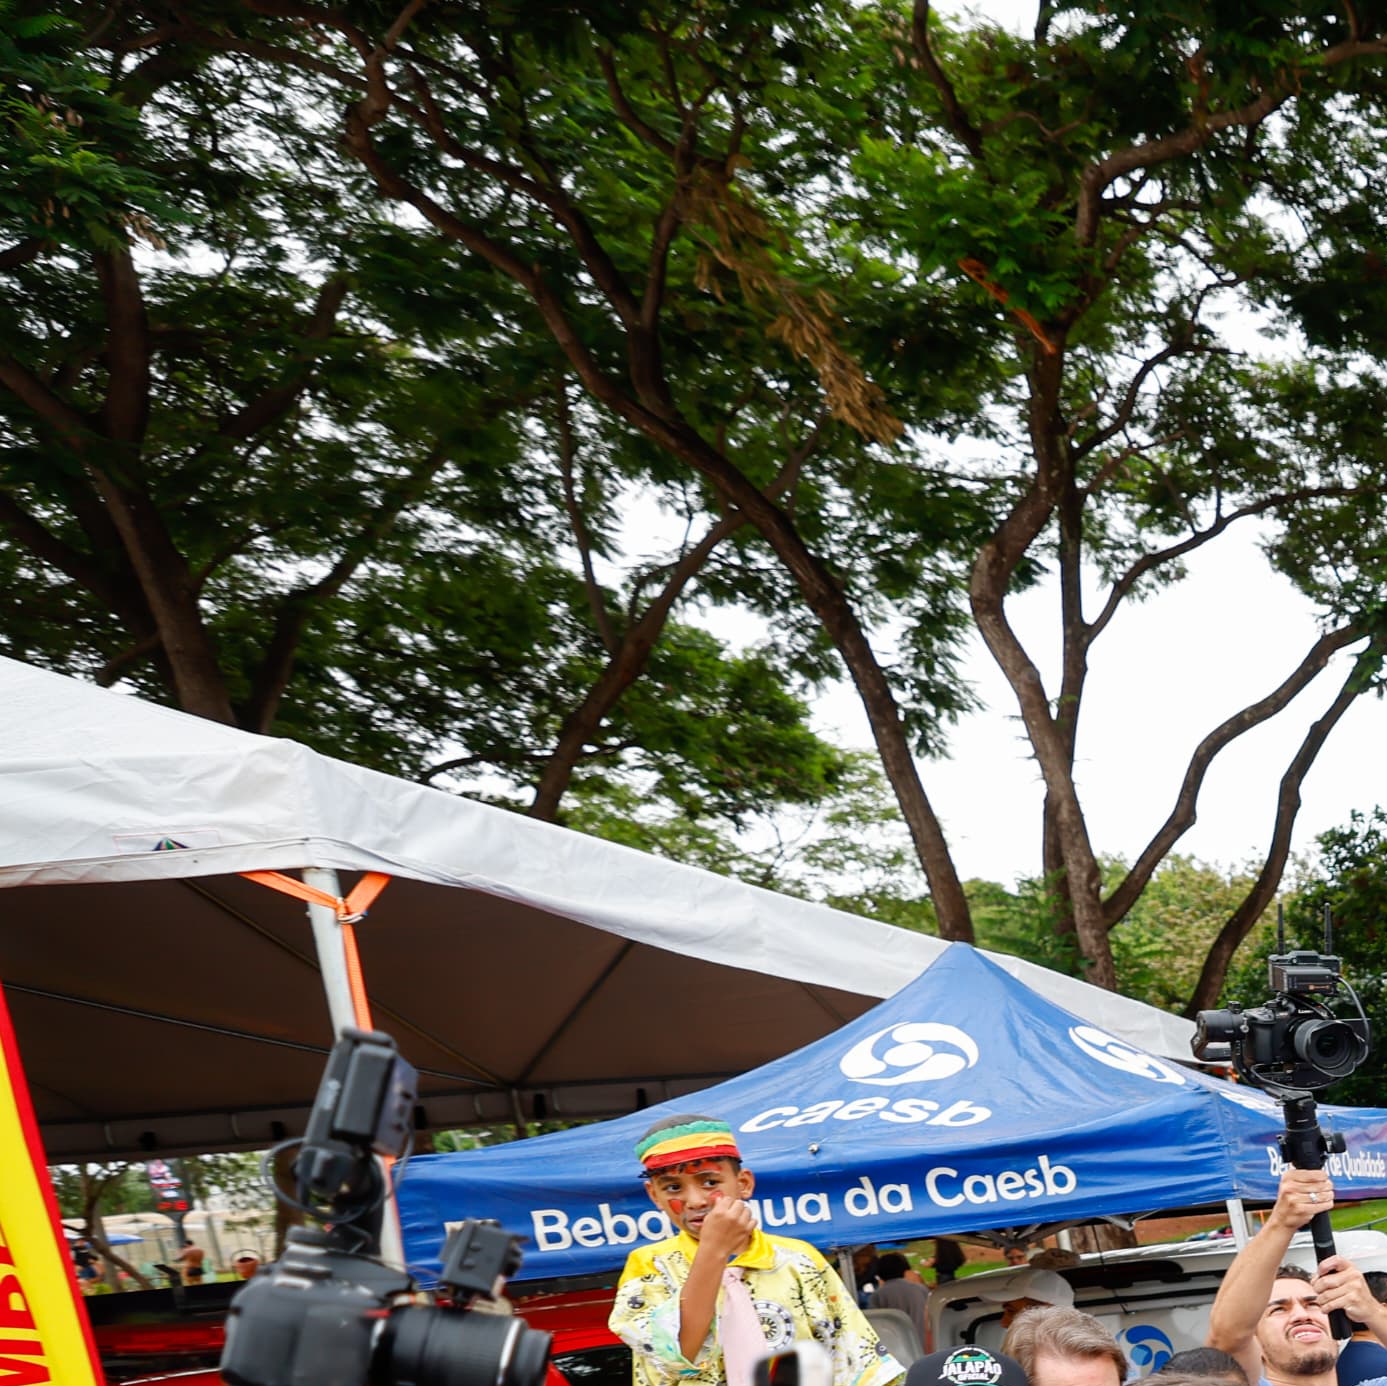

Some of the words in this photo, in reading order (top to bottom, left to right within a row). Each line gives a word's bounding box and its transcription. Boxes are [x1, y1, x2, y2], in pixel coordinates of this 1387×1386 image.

[739, 1097, 992, 1133] caesb
[1342, 1150, 1386, 1181] Qualidade
[530, 1203, 675, 1252] Beba
[844, 1176, 914, 1217] da
[925, 1154, 1077, 1209] Caesb
[938, 1360, 1002, 1379] JALAPÃO
